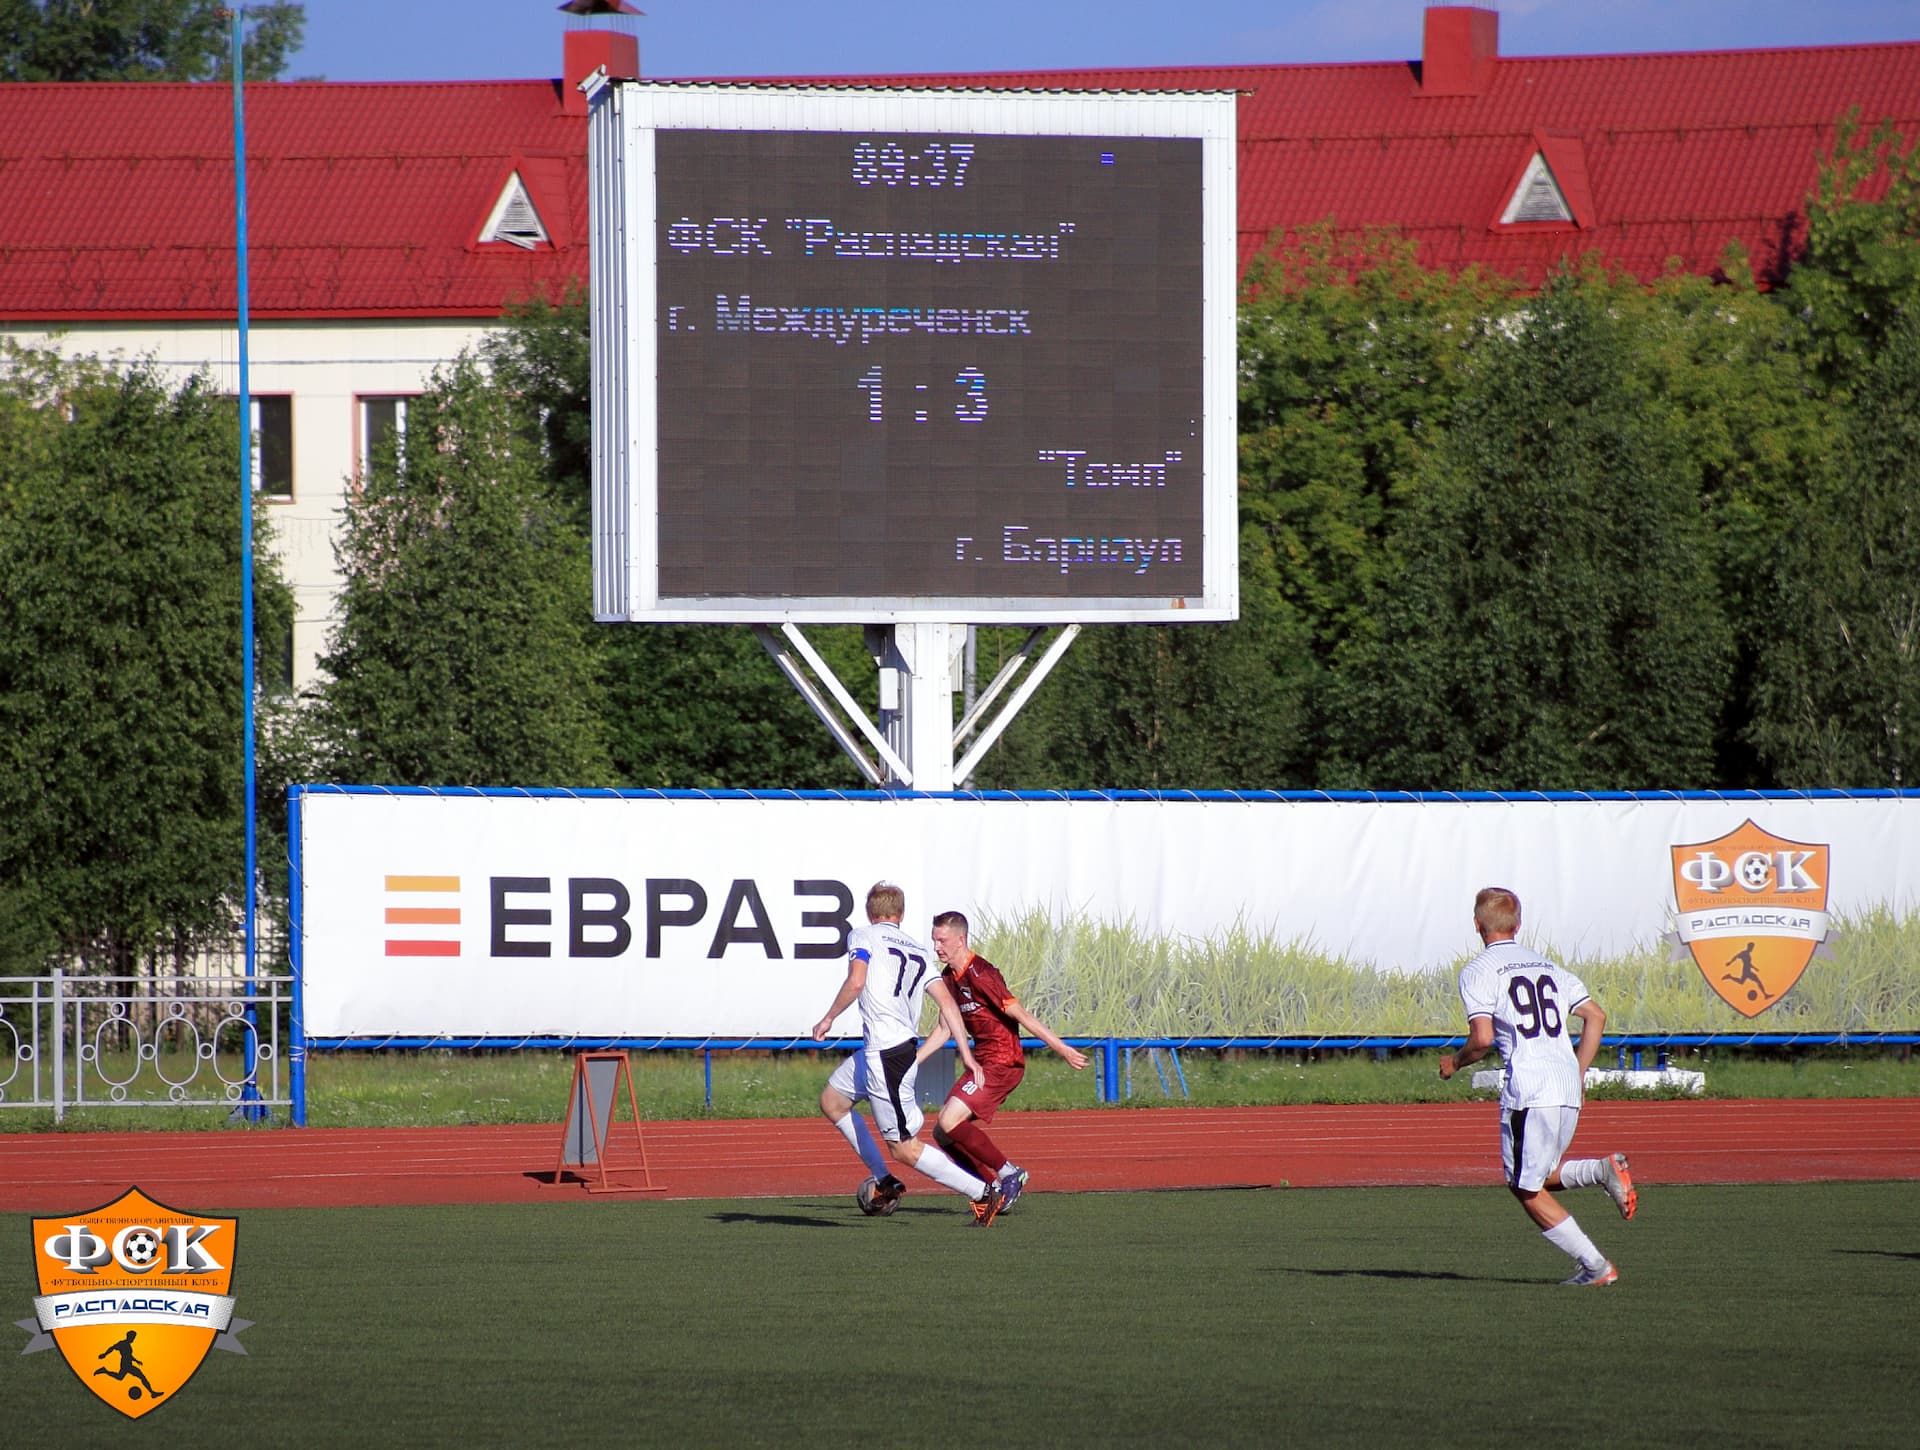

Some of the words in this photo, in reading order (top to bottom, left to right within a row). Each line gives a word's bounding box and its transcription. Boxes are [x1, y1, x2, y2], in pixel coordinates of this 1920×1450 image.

[852, 142, 975, 187] 89:37
[667, 217, 773, 255] ФСК
[669, 306, 695, 331] г.
[716, 294, 1031, 344] Междуреченск
[857, 366, 882, 422] 1
[955, 367, 989, 422] 3
[956, 537, 983, 561] г.
[1003, 525, 1182, 575] Барнаул
[1681, 851, 1822, 894] ФСК
[489, 876, 855, 960] ЕВРАЗ
[1690, 914, 1811, 932] РАСПАДСКАЯ
[887, 947, 927, 1000] 77
[1507, 974, 1562, 1040] 96
[961, 1080, 978, 1096] 20
